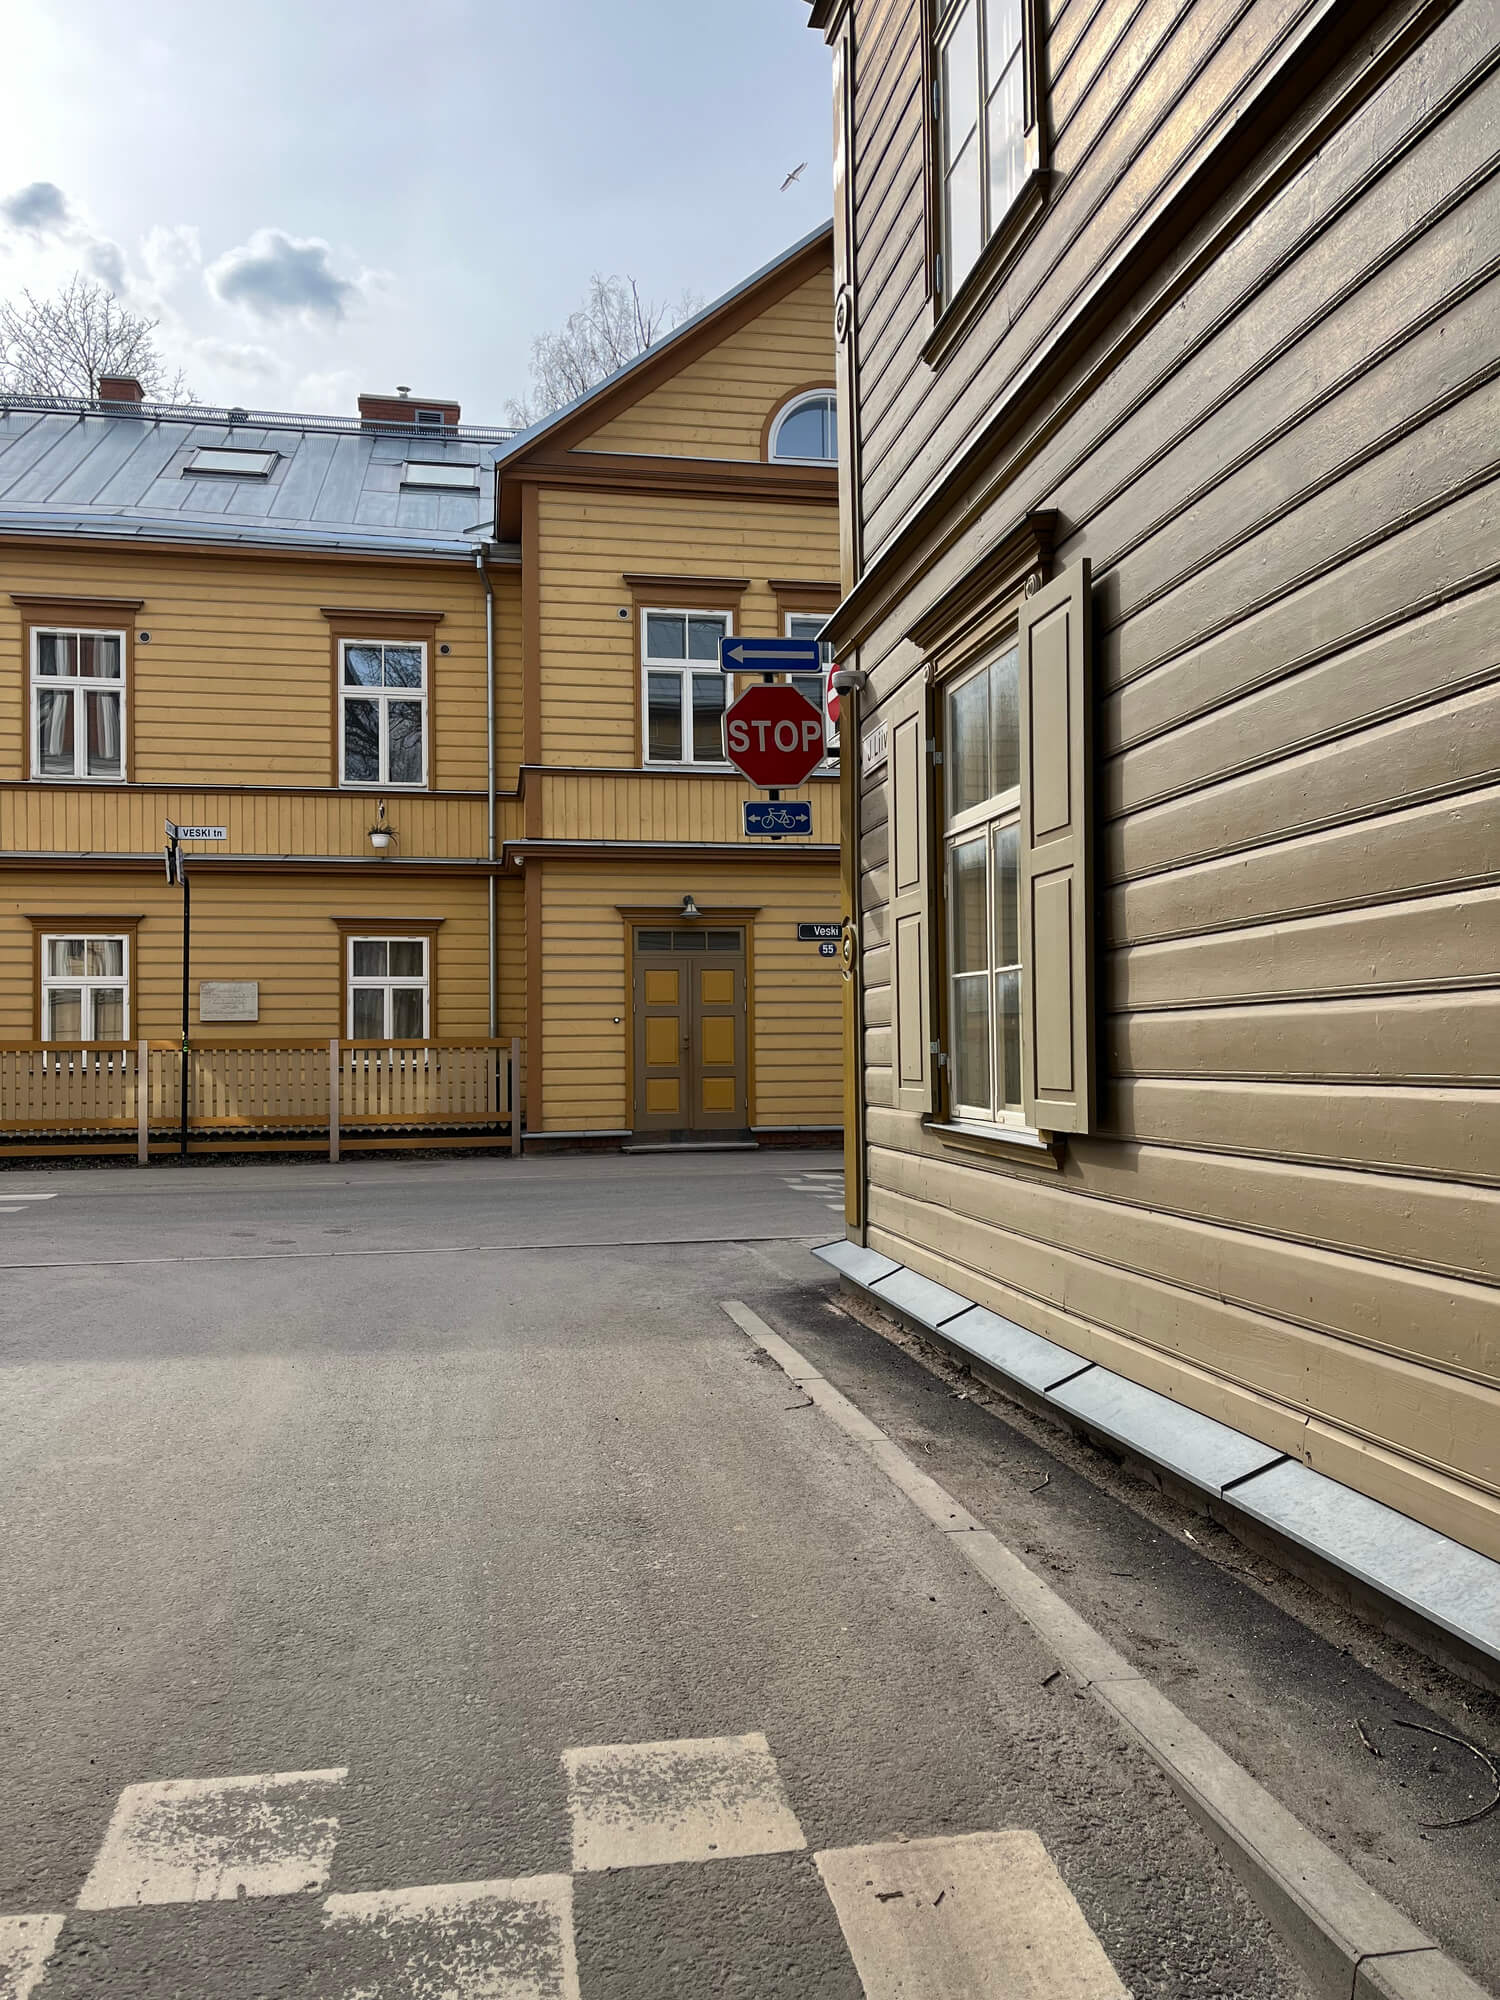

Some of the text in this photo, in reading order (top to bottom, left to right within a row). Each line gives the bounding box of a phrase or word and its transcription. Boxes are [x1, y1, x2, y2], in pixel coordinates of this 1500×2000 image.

[728, 719, 822, 753] STOP
[182, 828, 211, 837] VESKI
[213, 829, 223, 837] tn
[813, 925, 839, 936] Veski
[822, 944, 834, 954] 55
